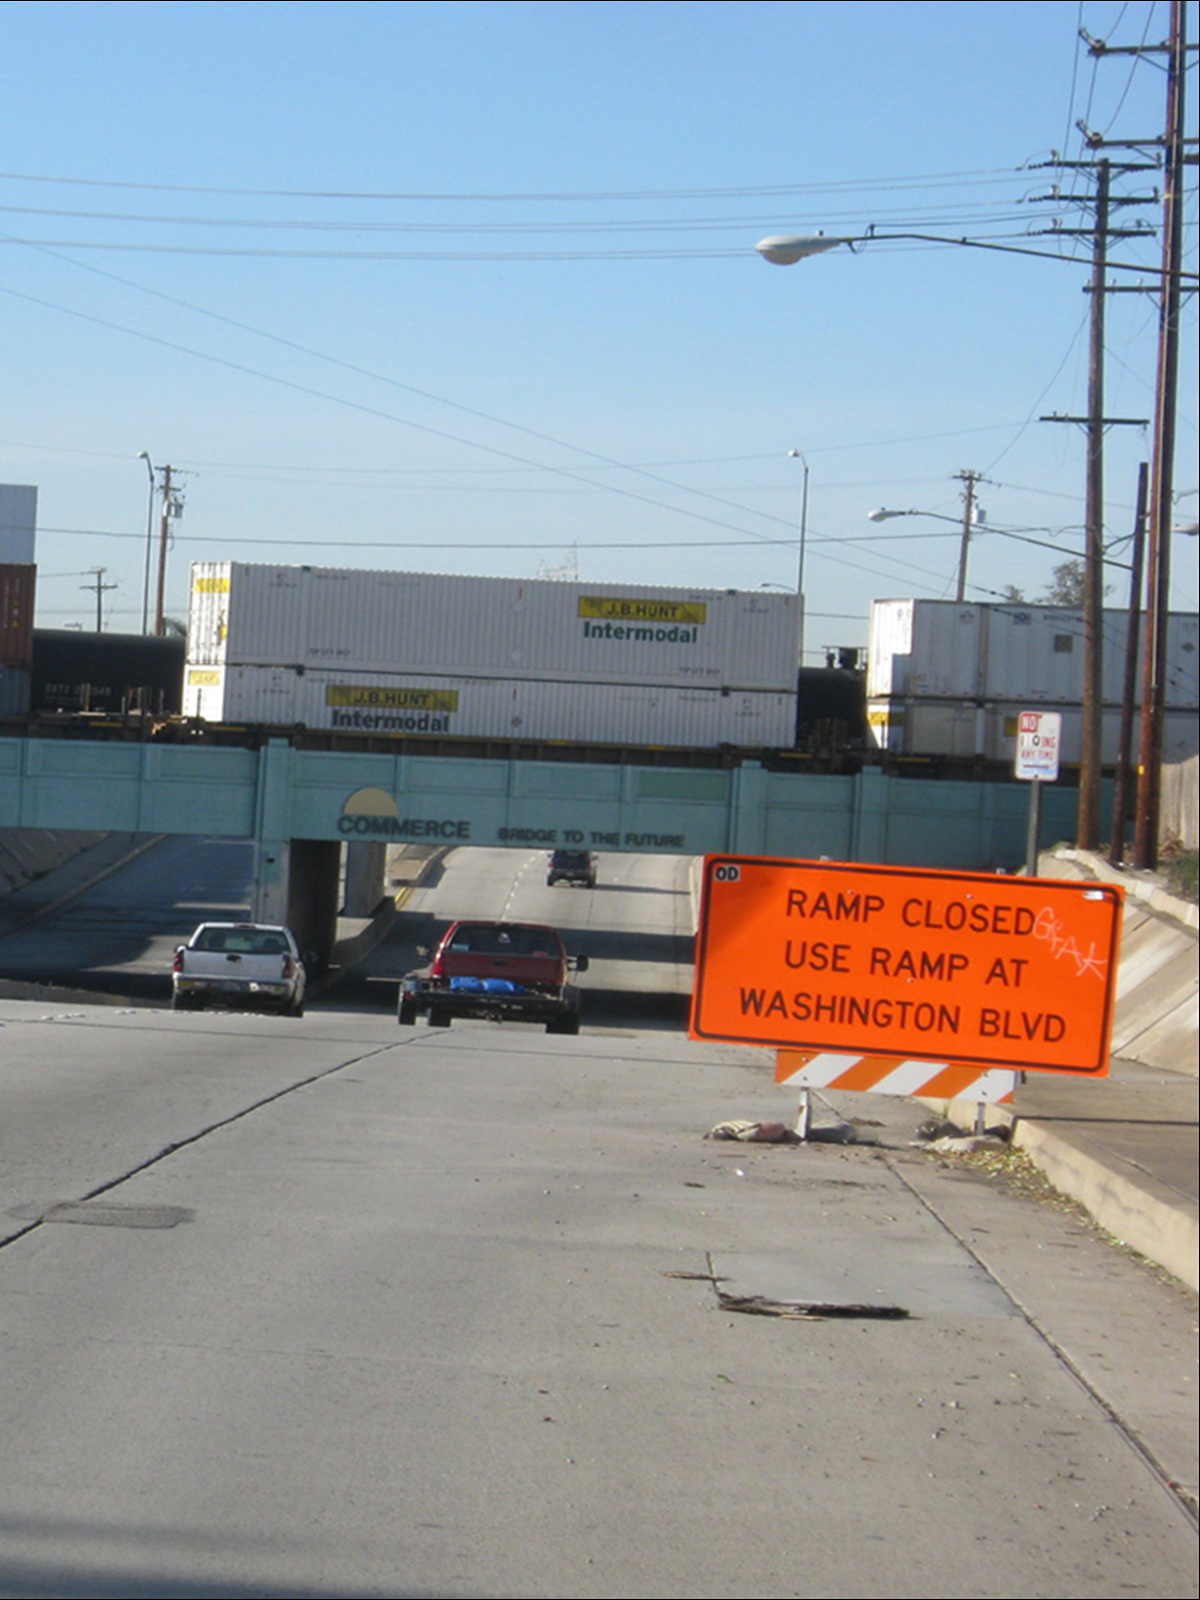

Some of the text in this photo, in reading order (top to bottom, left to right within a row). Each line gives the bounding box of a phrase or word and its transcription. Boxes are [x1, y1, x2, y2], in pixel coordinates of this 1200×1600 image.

[583, 621, 698, 644] Intermodal
[331, 709, 450, 733] Intermodal
[1021, 714, 1038, 731] NO
[337, 814, 471, 839] COMMERCE
[498, 826, 686, 848] BRIDGE TO THE FUTURE
[716, 866, 739, 882] OD
[786, 889, 1036, 936] RAMP CLOSED
[784, 940, 1029, 988] USE RAMP AT
[739, 987, 1067, 1044] WASHINGTON BLVD
